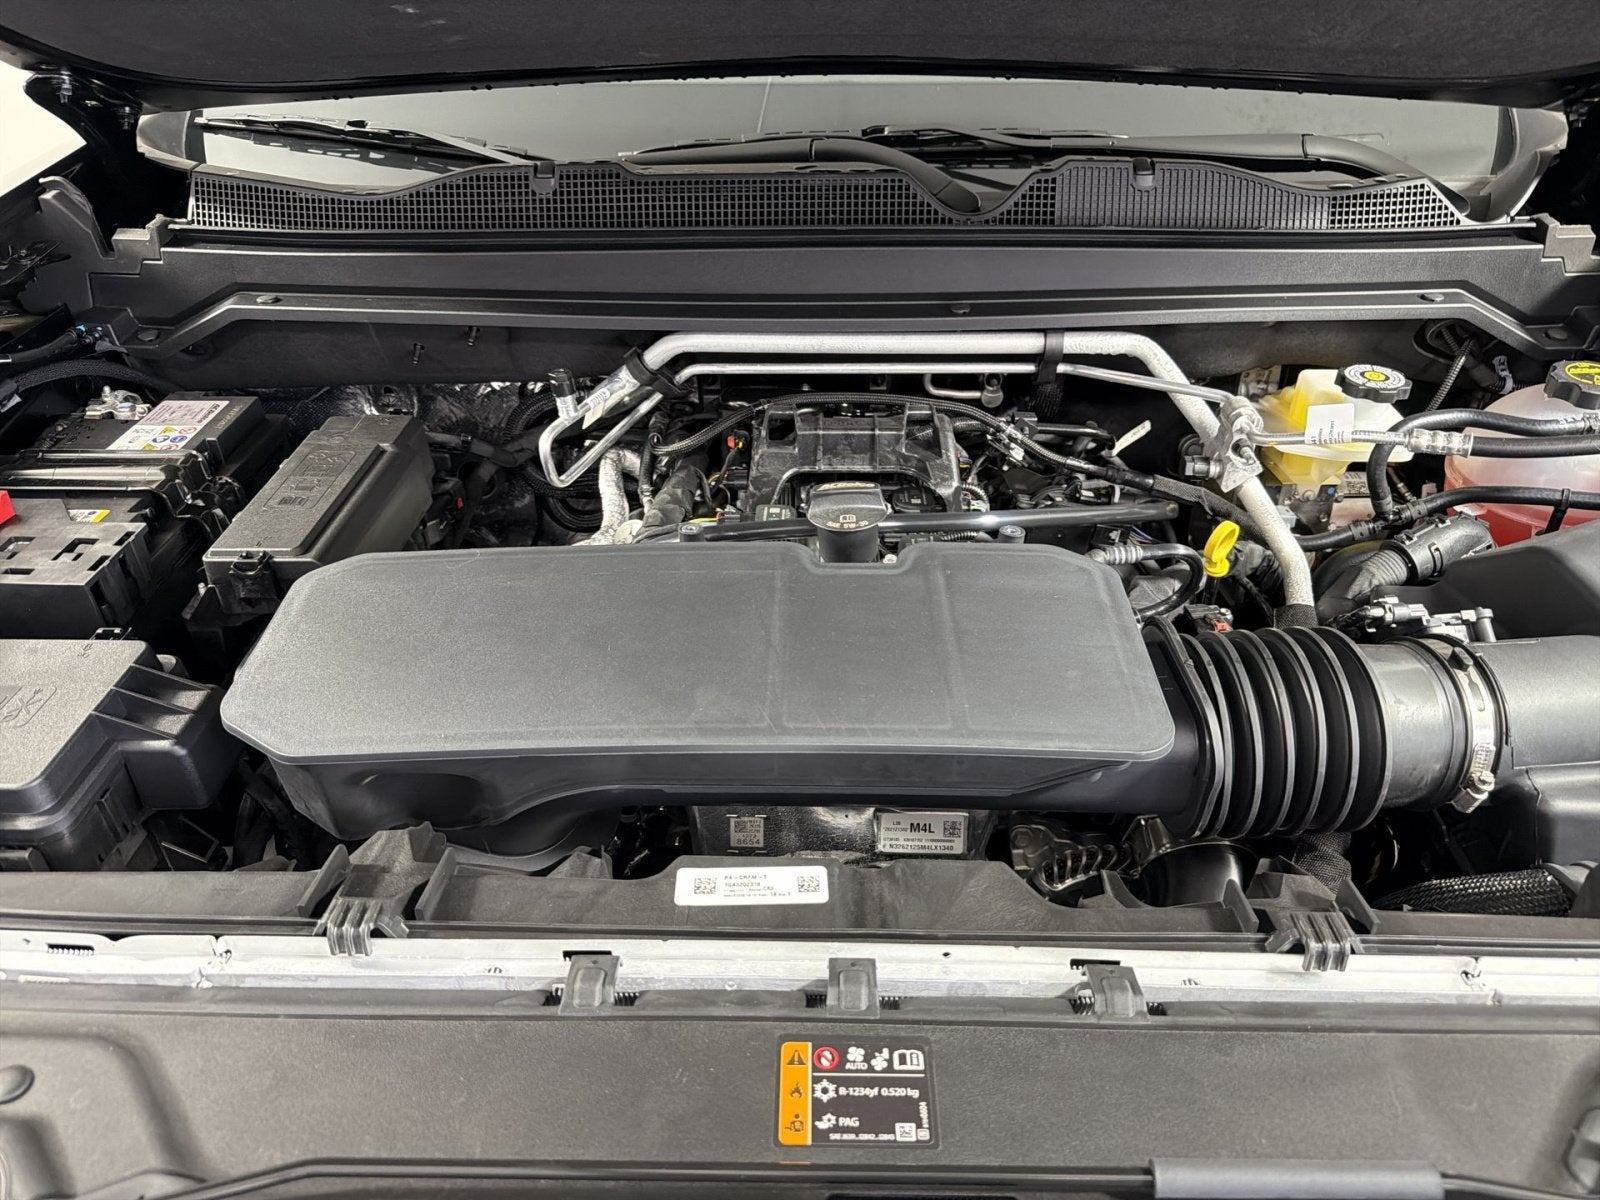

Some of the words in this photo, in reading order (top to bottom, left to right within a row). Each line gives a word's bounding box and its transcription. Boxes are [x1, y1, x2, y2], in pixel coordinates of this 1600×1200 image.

[909, 822, 936, 834] M4L
[845, 1062, 868, 1070] AUTO
[838, 1086, 880, 1099] R-1234yf
[880, 1086, 907, 1097] 0.520
[907, 1086, 920, 1099] kg
[838, 1117, 860, 1127] PAG
